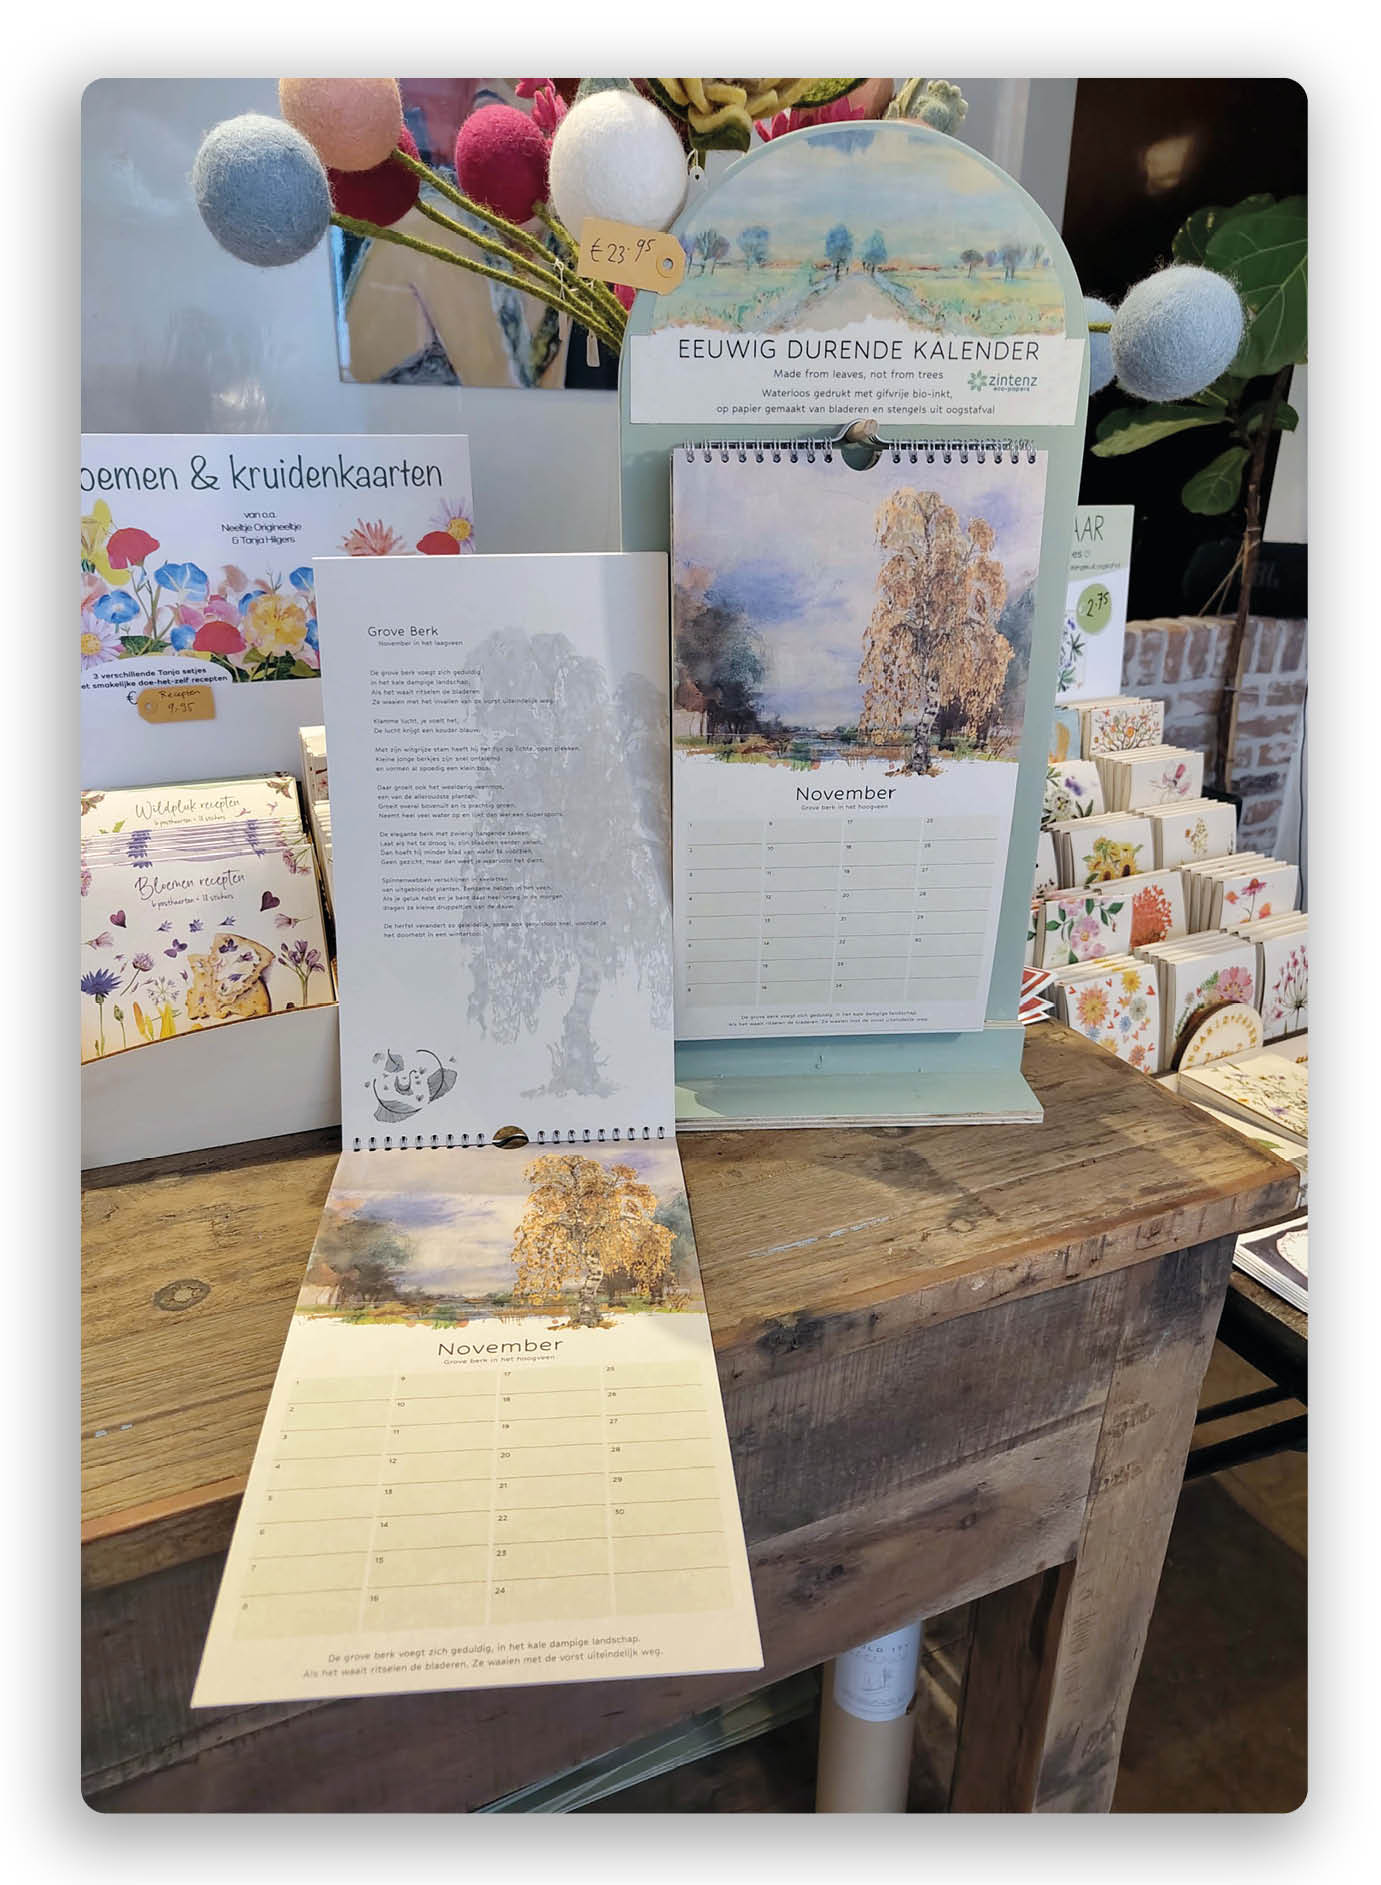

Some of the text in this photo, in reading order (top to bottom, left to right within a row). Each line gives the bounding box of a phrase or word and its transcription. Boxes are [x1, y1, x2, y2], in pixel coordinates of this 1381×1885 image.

[591, 238, 602, 262] €
[679, 339, 1040, 361] EEUWIG DURENDE KALENDER
[774, 369, 944, 380] Made from leaves, not from trees
[988, 374, 1038, 387] zintenz
[762, 388, 953, 400] Waterloos gedrukt met gifvrije bio-inkt,
[716, 403, 996, 416] op papier gemaakt van bladeren en stengels uit oogstafval
[190, 454, 221, 491] &
[230, 453, 443, 491] kruidenkaarten
[240, 536, 265, 545] Tanja
[266, 535, 296, 545] Hilgers
[368, 626, 439, 636] Grove Berk
[101, 670, 156, 679] verschillende
[158, 668, 181, 678] Tanja
[182, 667, 207, 676] setjes
[92, 680, 136, 690] smakelijke
[138, 677, 190, 686] doe-het-zelf
[191, 675, 228, 684] recepten
[797, 785, 896, 800] November
[135, 795, 241, 820] Wildpluk recepten
[134, 869, 246, 901] Bloemen recepten
[438, 1339, 563, 1356] November
[328, 1635, 640, 1663] De grove berk voegt zich geduldig, in het kale dampige landschap.
[322, 1669, 338, 1677] het
[371, 1664, 407, 1674] ritselen
[425, 1661, 469, 1670] bladeren.
[472, 1659, 484, 1668] Ze
[488, 1657, 520, 1667] waaien
[523, 1656, 541, 1664] met
[545, 1654, 556, 1663] de
[560, 1652, 583, 1662] vorst
[588, 1649, 640, 1660] uiteindelijk
[641, 1649, 663, 1657] weg.
